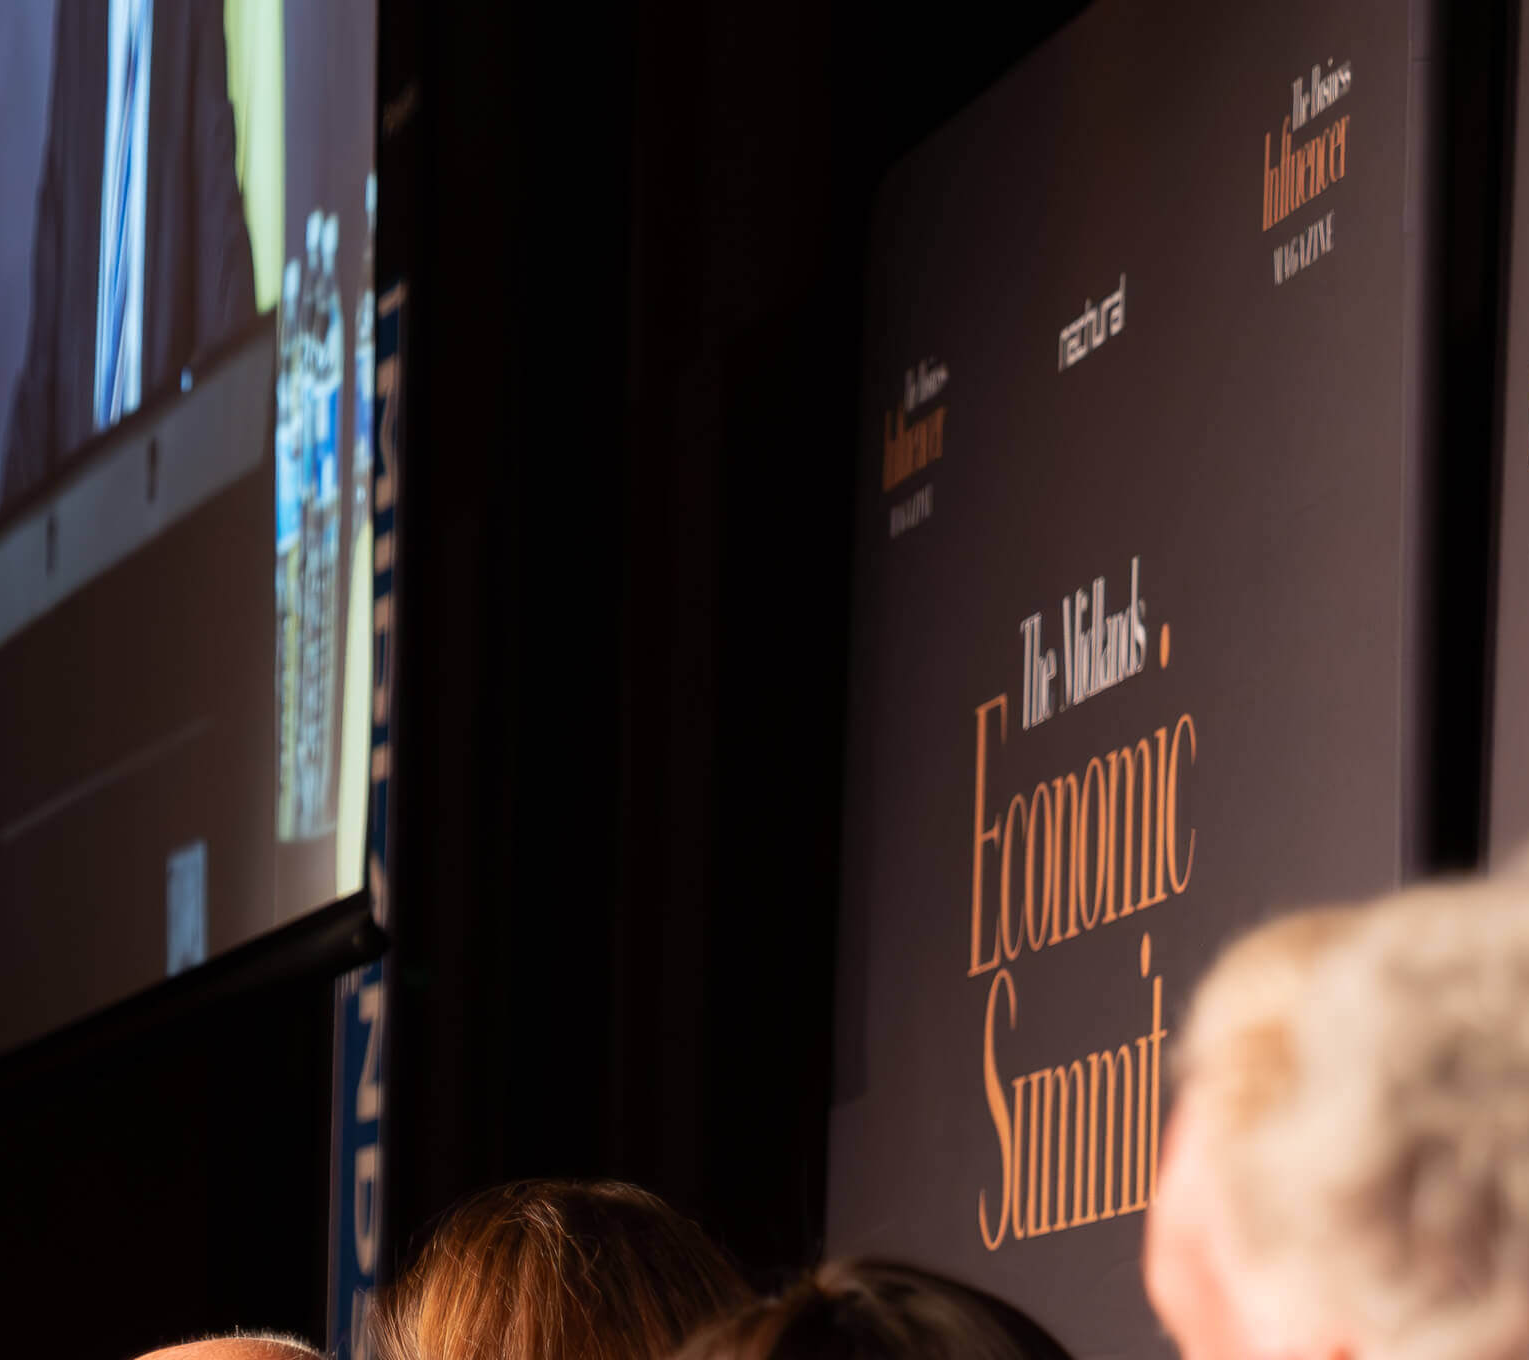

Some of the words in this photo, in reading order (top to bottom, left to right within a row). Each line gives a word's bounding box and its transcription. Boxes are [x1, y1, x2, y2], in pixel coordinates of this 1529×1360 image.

[1262, 113, 1351, 232] Influencer
[1020, 612, 1057, 731] The
[1059, 555, 1148, 712] Midlands
[967, 622, 1198, 979] Economic
[978, 932, 1168, 1253] Summit
